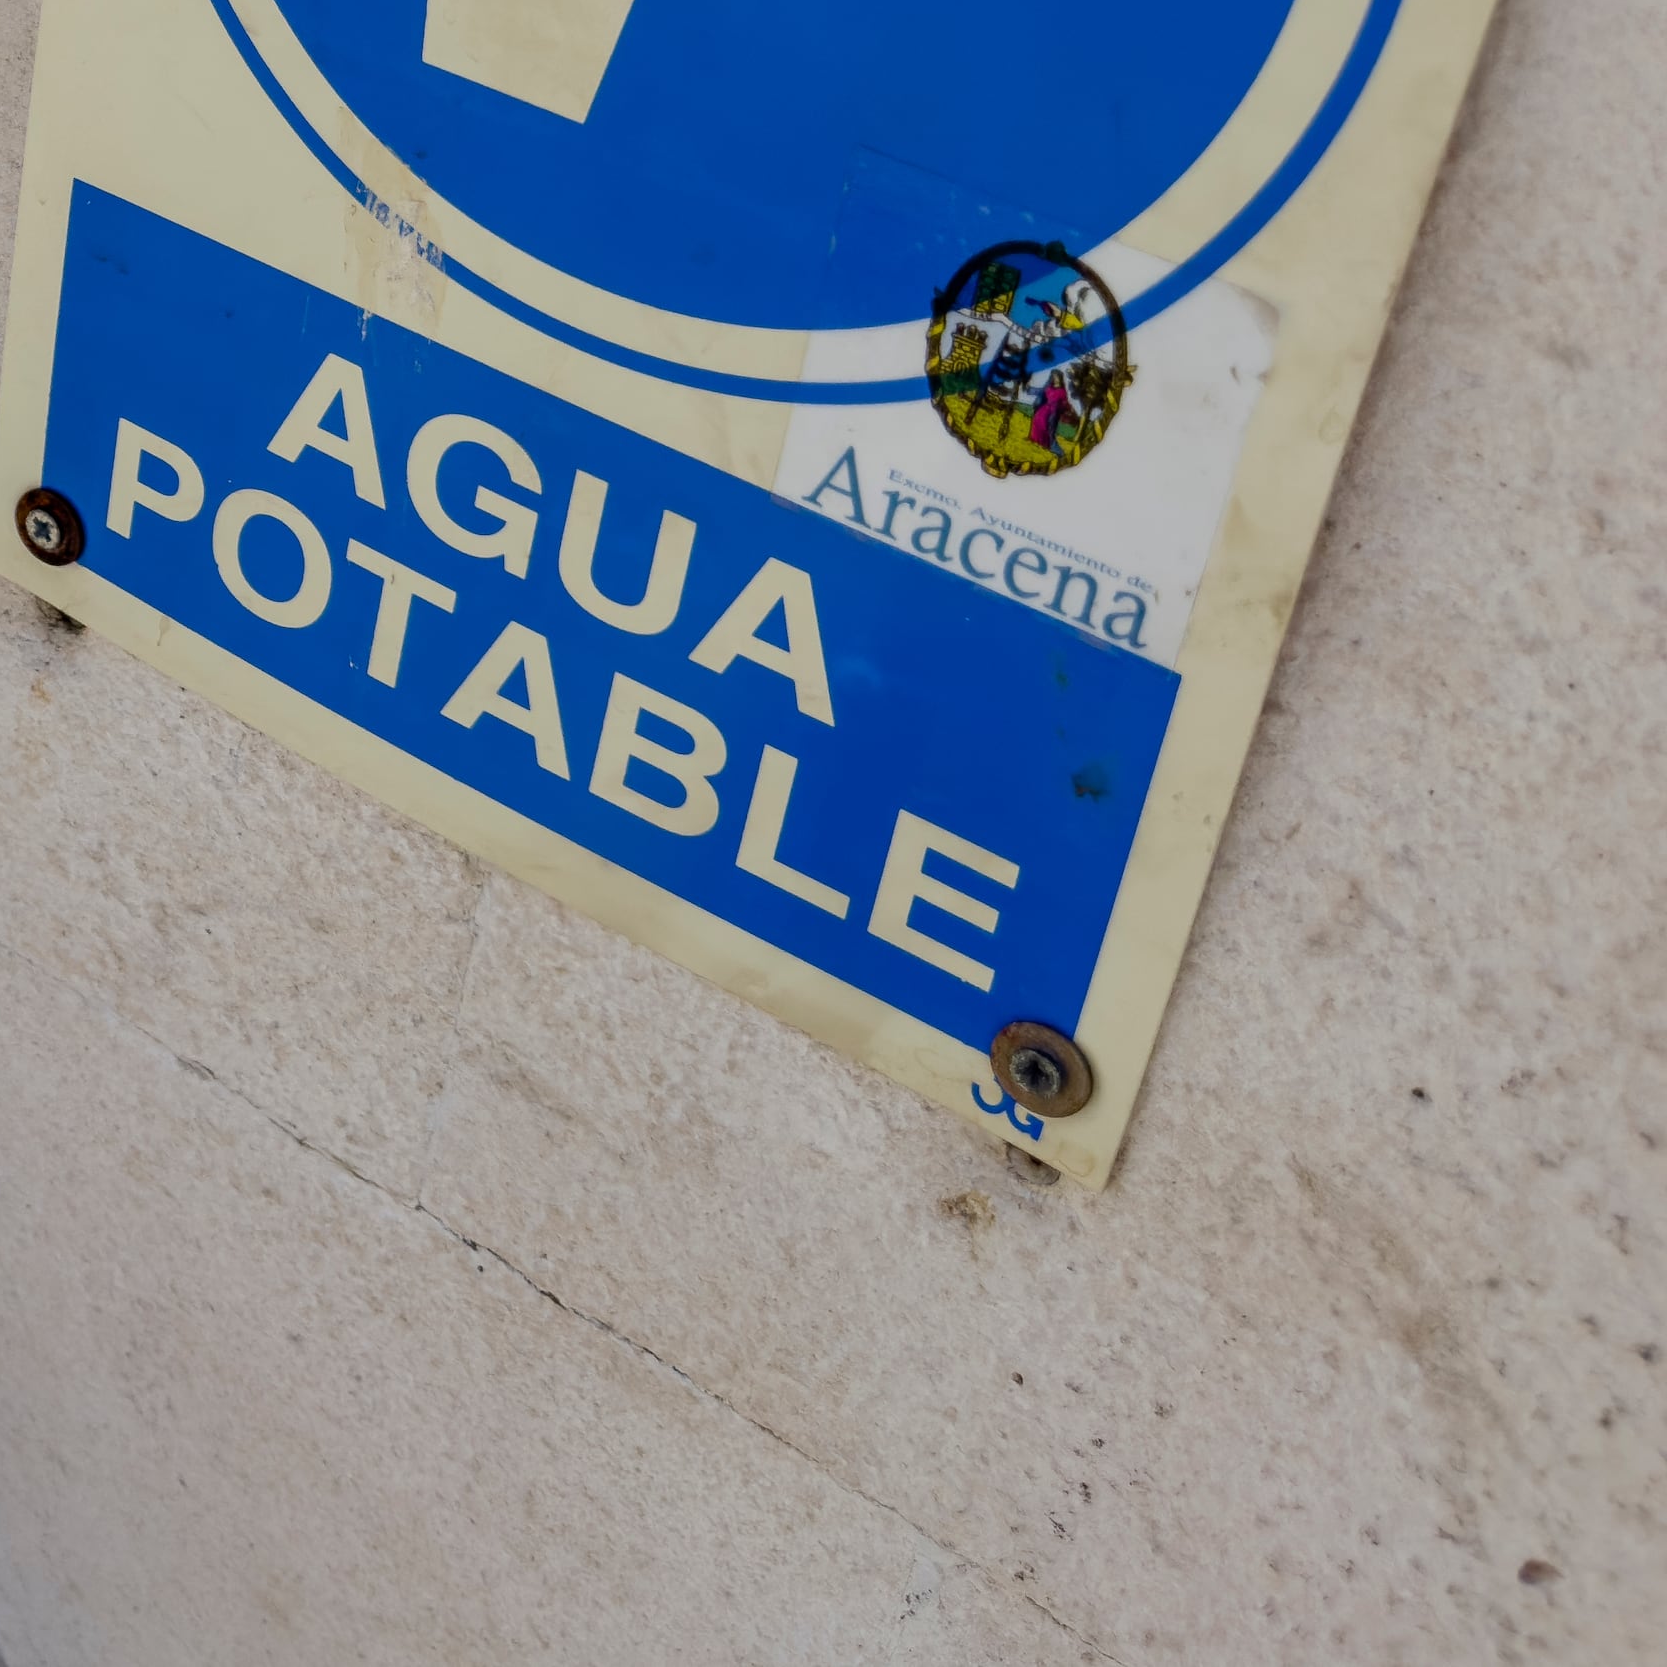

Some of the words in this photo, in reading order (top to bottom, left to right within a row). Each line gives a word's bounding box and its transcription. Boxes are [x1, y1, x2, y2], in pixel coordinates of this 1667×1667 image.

[267, 354, 835, 726] AGUA
[802, 445, 1147, 649] Aracena
[970, 506, 1121, 578] Ayuntamiento
[1126, 575, 1154, 593] de
[105, 417, 1020, 992] POTABLE
